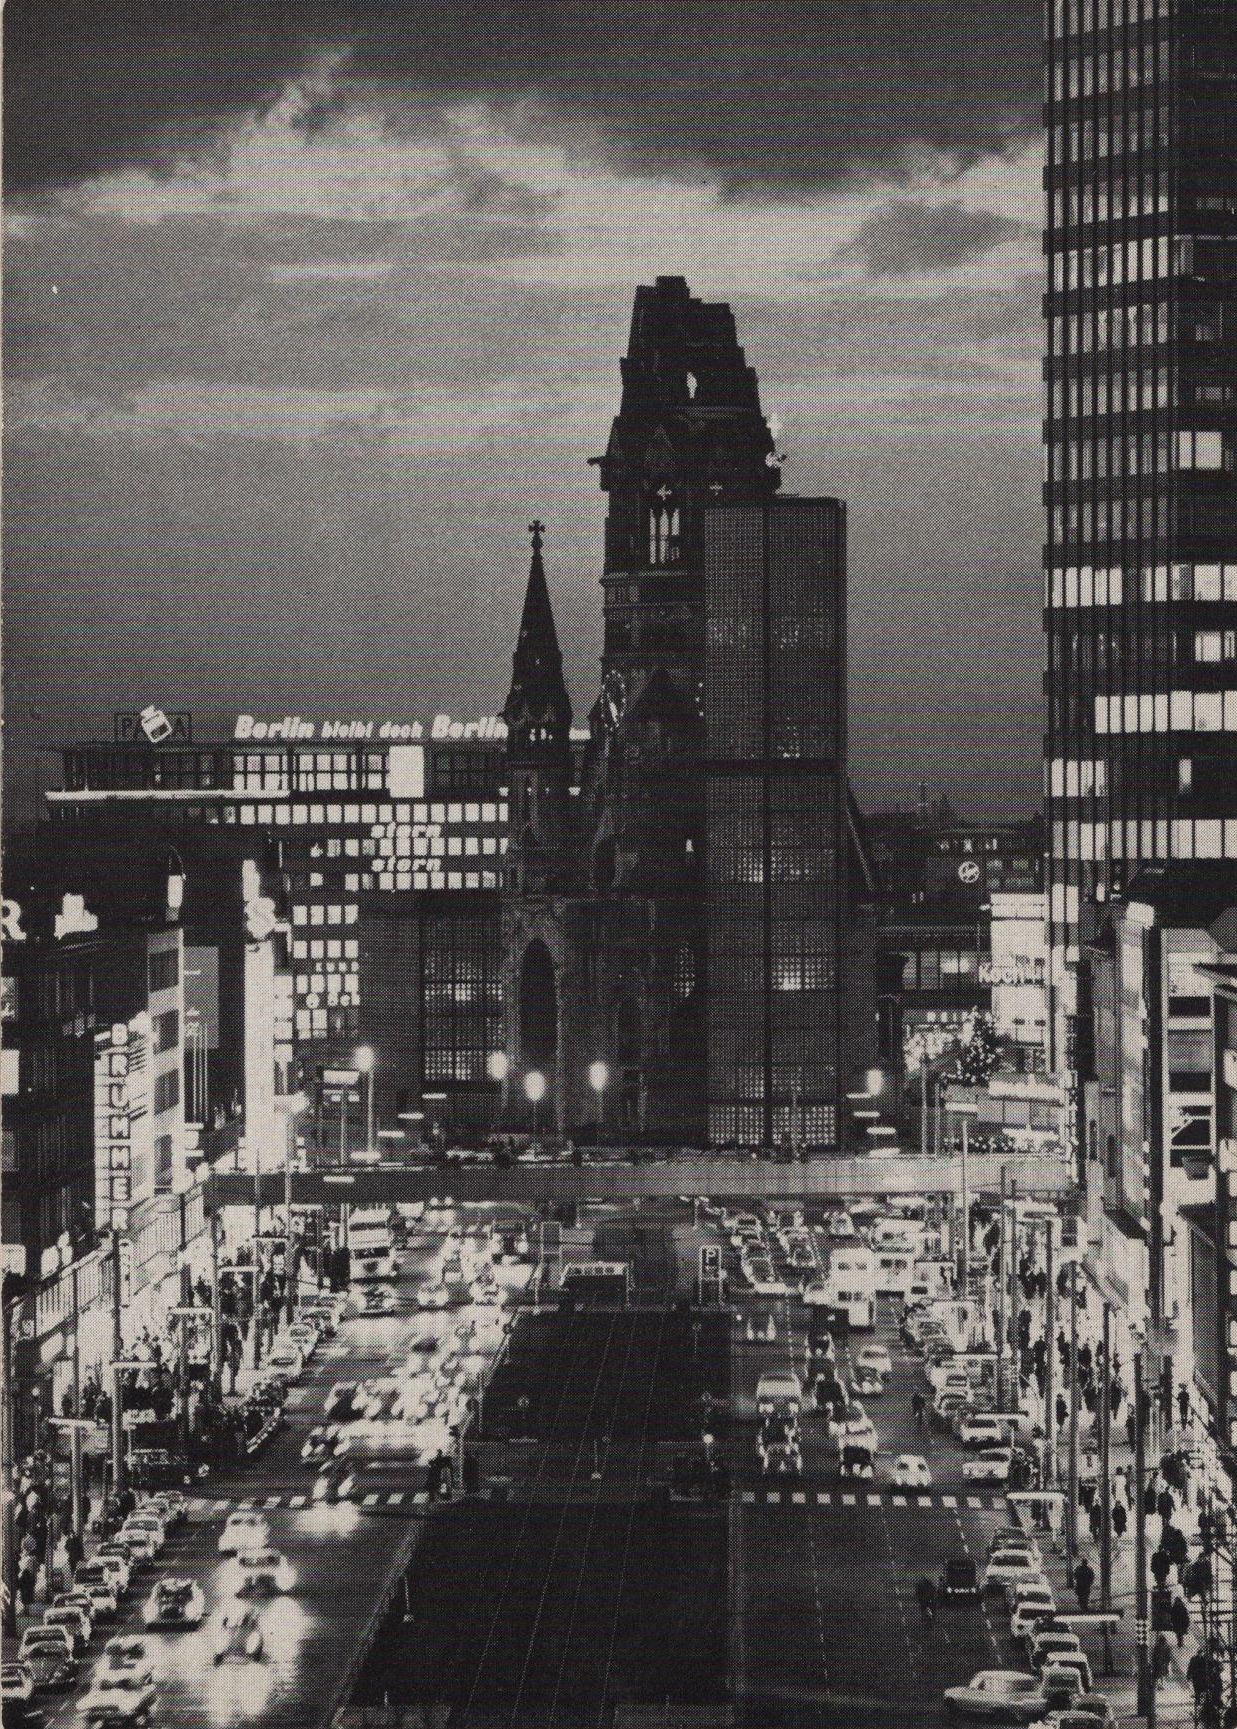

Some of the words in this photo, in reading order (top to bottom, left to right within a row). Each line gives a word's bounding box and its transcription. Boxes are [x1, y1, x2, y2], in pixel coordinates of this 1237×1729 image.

[235, 715, 315, 738] Berlin
[321, 720, 374, 738] bleibt
[379, 720, 423, 738] doch
[431, 714, 509, 738] Berlin
[371, 822, 441, 838] stern
[371, 856, 441, 872] stern
[110, 1023, 130, 1231] BRUMMER
